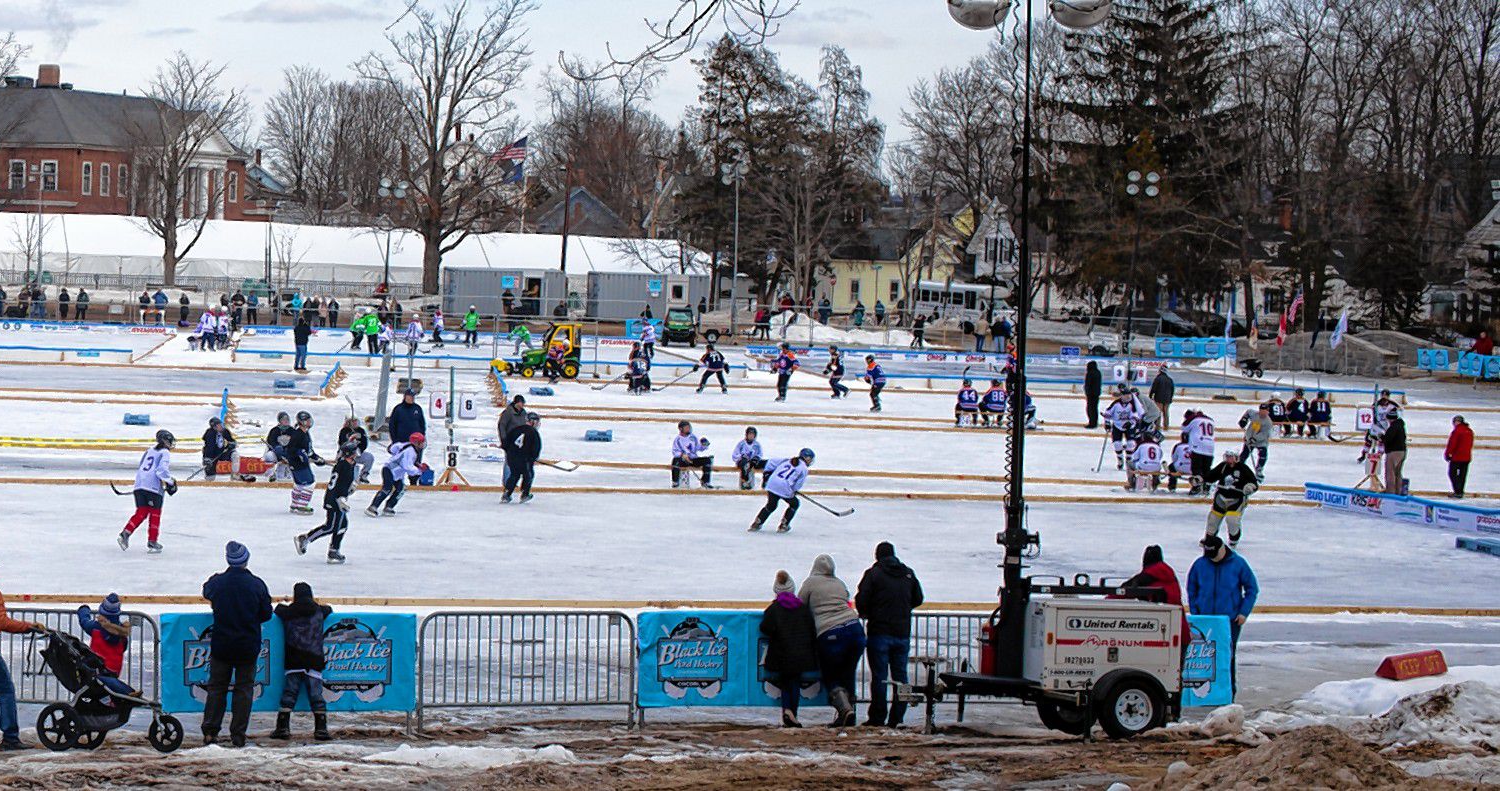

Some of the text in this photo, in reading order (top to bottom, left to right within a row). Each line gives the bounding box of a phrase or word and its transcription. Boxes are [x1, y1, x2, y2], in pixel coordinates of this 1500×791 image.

[962, 390, 976, 401] 44
[435, 398, 442, 409] 4
[465, 399, 472, 411] 6
[1361, 413, 1371, 424] 12
[1199, 422, 1214, 436] 10
[514, 433, 525, 449] 4
[448, 452, 457, 467] 8
[1147, 446, 1156, 460] 6
[143, 456, 155, 471] 3
[216, 461, 265, 473] KEE OFF
[1369, 459, 1378, 474] 7
[777, 465, 796, 480] 21
[1307, 489, 1348, 506] BUD LIGHT
[1083, 619, 1155, 630] United Rentals
[365, 642, 392, 658] Ice
[658, 640, 728, 666] Black Ice
[1197, 643, 1217, 659] Ice
[327, 661, 388, 673] Pond Hockey
[674, 658, 724, 670] Pond Hockey
